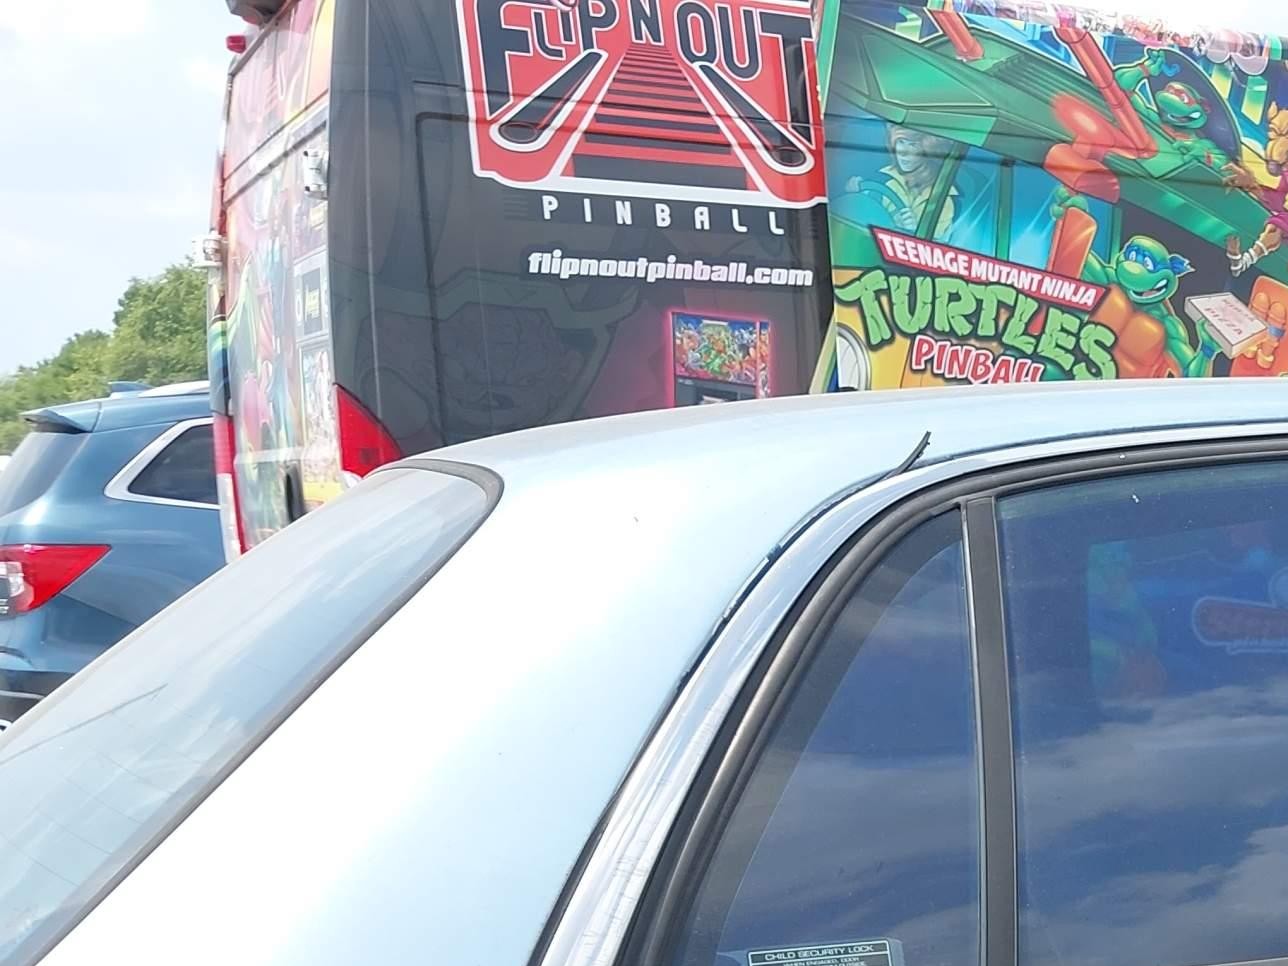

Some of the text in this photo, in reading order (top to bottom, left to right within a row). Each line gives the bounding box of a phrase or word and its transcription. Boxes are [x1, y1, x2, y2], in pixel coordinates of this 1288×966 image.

[673, 1, 815, 150] OUT
[541, 194, 786, 237] PINBALL
[527, 248, 814, 287] flipnoutpinball.com
[878, 233, 1099, 309] TEENAGE MUTANT NINJA
[834, 268, 1118, 381] TURTLES
[764, 945, 874, 960] CHILD SECURITY LOCK
